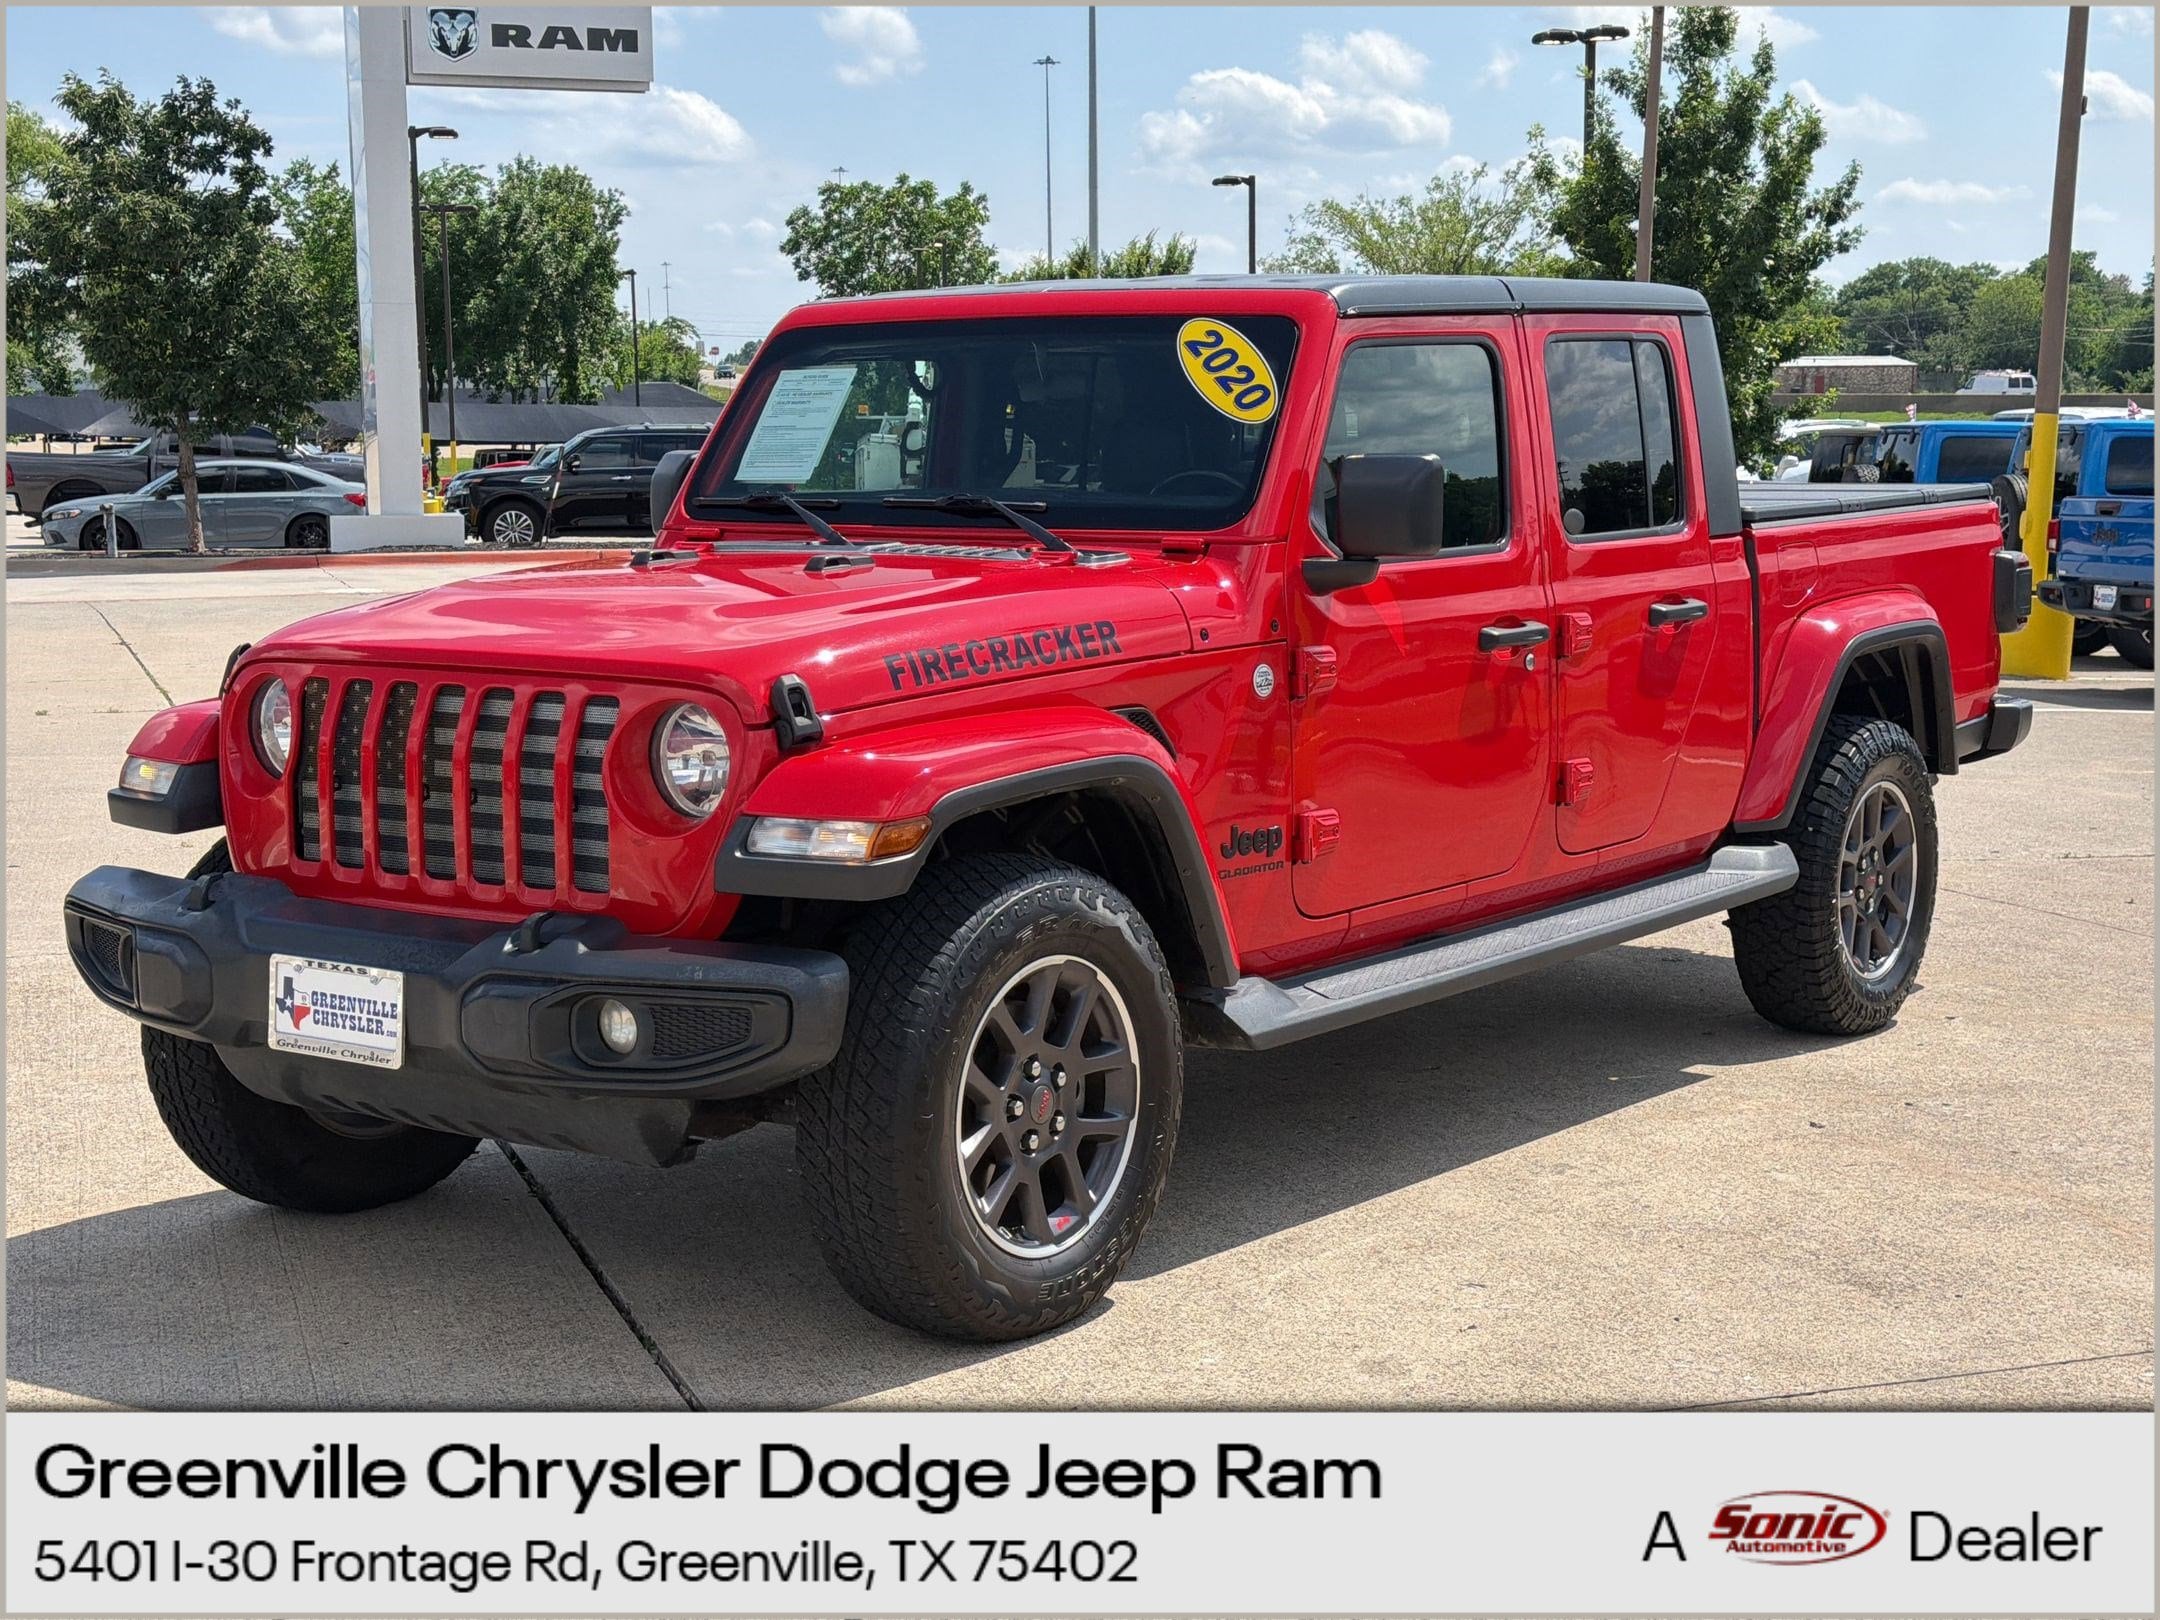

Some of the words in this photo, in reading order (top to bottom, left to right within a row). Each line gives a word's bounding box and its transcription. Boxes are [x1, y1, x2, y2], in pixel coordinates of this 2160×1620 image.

[491, 23, 639, 53] RAM
[1183, 329, 1271, 410] 2020
[882, 620, 1122, 690] FIRECRACKER
[1220, 824, 1283, 859] Jeep
[1218, 860, 1284, 880] GLADIATOR
[305, 960, 368, 975] TEXAS
[311, 990, 398, 1019] GREENVILLE
[312, 1009, 385, 1036] CHRYSLER
[276, 1038, 337, 1056] Greenville
[340, 1049, 392, 1065] Chrysler
